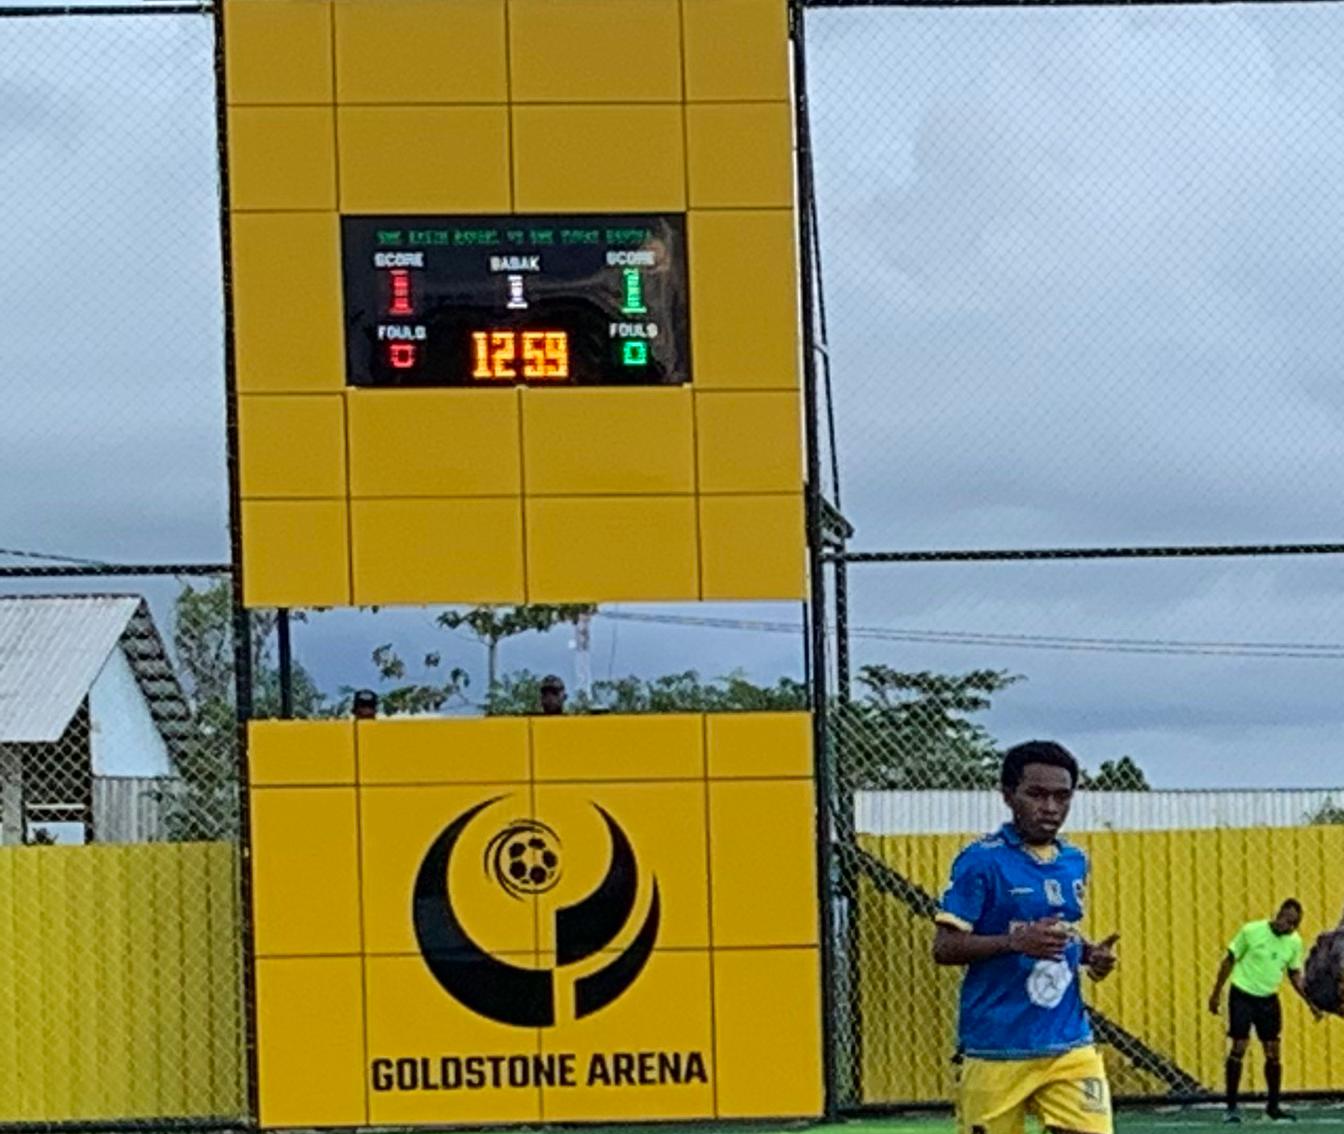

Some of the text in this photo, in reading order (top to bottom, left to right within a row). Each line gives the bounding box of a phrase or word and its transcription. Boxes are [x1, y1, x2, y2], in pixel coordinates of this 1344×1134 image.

[374, 252, 424, 267] SCORE
[490, 256, 540, 272] BABAK
[606, 250, 655, 266] SCORE
[378, 326, 426, 340] FOULS
[609, 323, 658, 338] FOULS
[371, 1051, 708, 1091] GOLDSTONE ARENA
